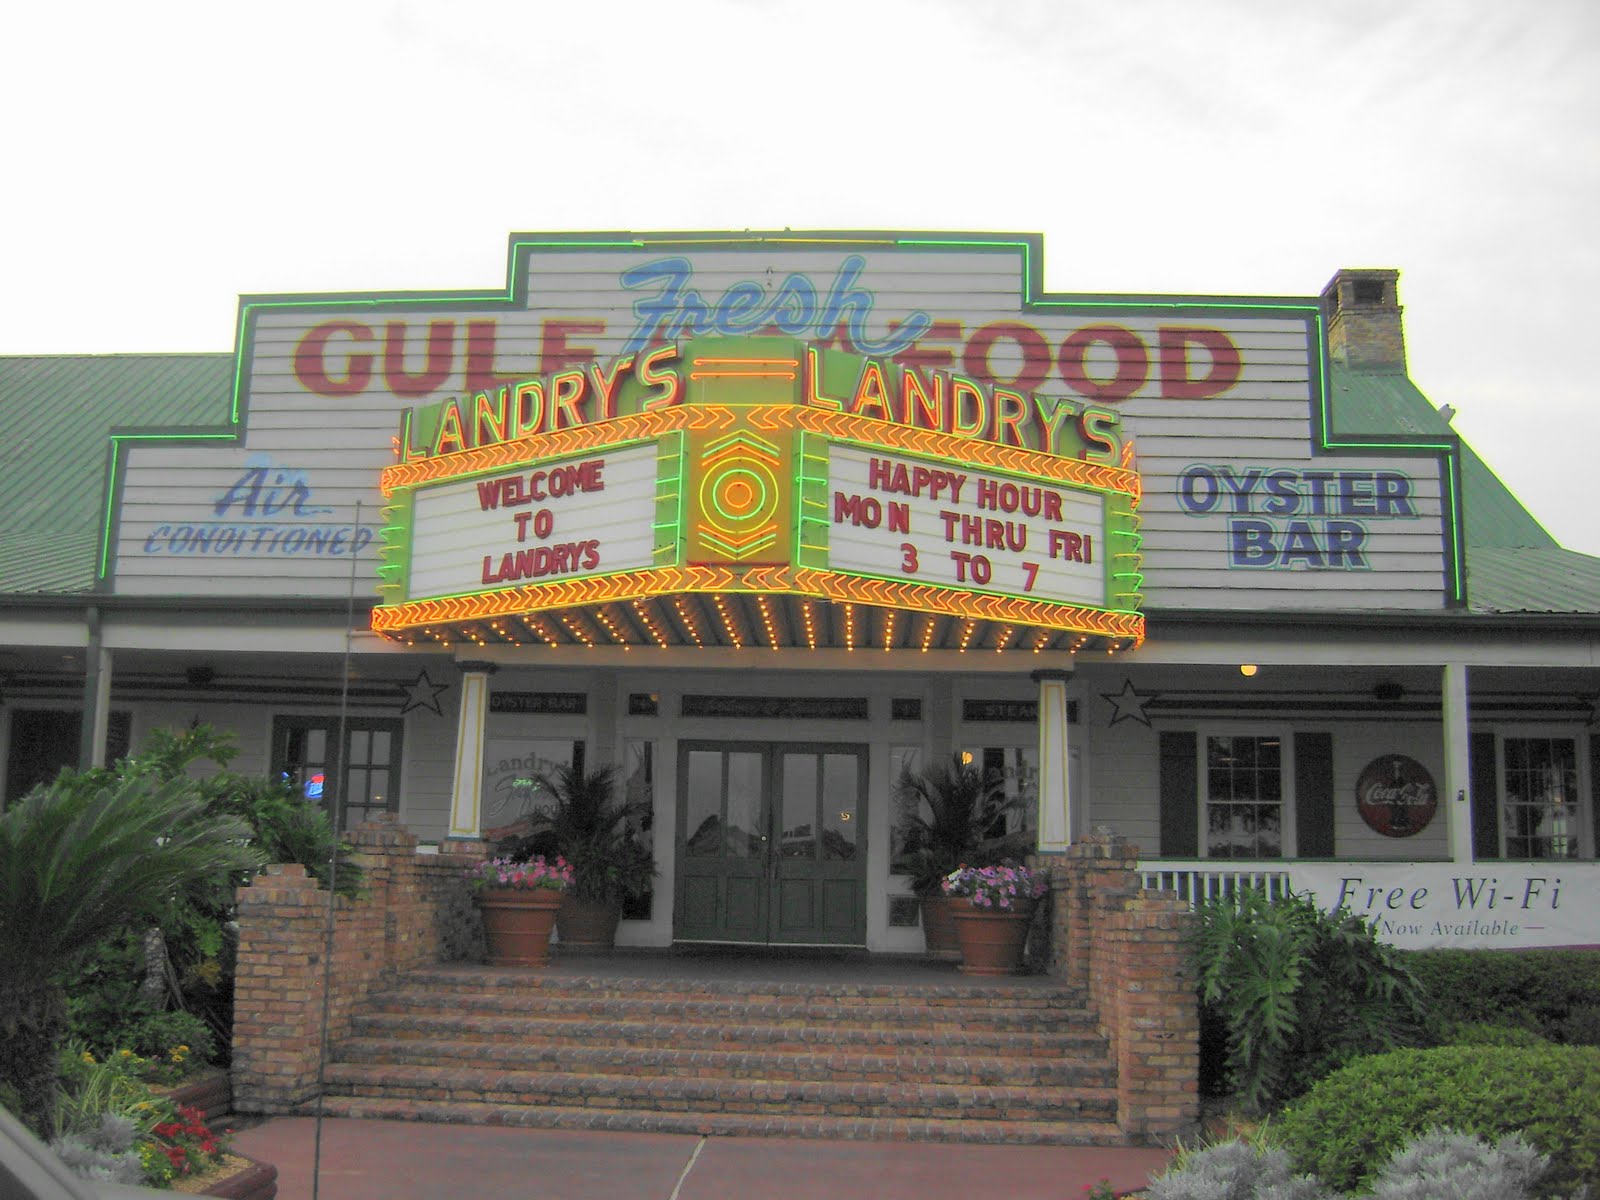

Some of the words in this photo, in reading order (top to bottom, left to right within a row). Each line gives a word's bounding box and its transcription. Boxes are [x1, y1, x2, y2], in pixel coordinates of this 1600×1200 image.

[620, 255, 932, 359] Fresh
[292, 319, 607, 399] GULF
[401, 342, 687, 466] LANDRY'S
[802, 340, 1124, 469] LANDRY'S
[212, 456, 333, 519] Air
[477, 459, 605, 511] WELCOME
[869, 458, 967, 504] HAPPY
[977, 478, 1063, 522] HOUR
[1177, 464, 1420, 520] OYSTER
[143, 524, 373, 556] CONDITIONED
[514, 509, 554, 542] TO
[834, 492, 910, 534] MON
[940, 510, 1027, 552] THRU
[1049, 529, 1092, 564] FRI
[1227, 517, 1374, 571] BAR
[482, 539, 601, 584] LANDRYS
[900, 543, 919, 573] 3
[951, 551, 992, 585] TO
[1022, 561, 1040, 592] 7
[1329, 878, 1428, 918] Free
[1452, 878, 1562, 910] Wi-Fi
[1381, 920, 1422, 936] Now
[1430, 920, 1519, 936] Available
